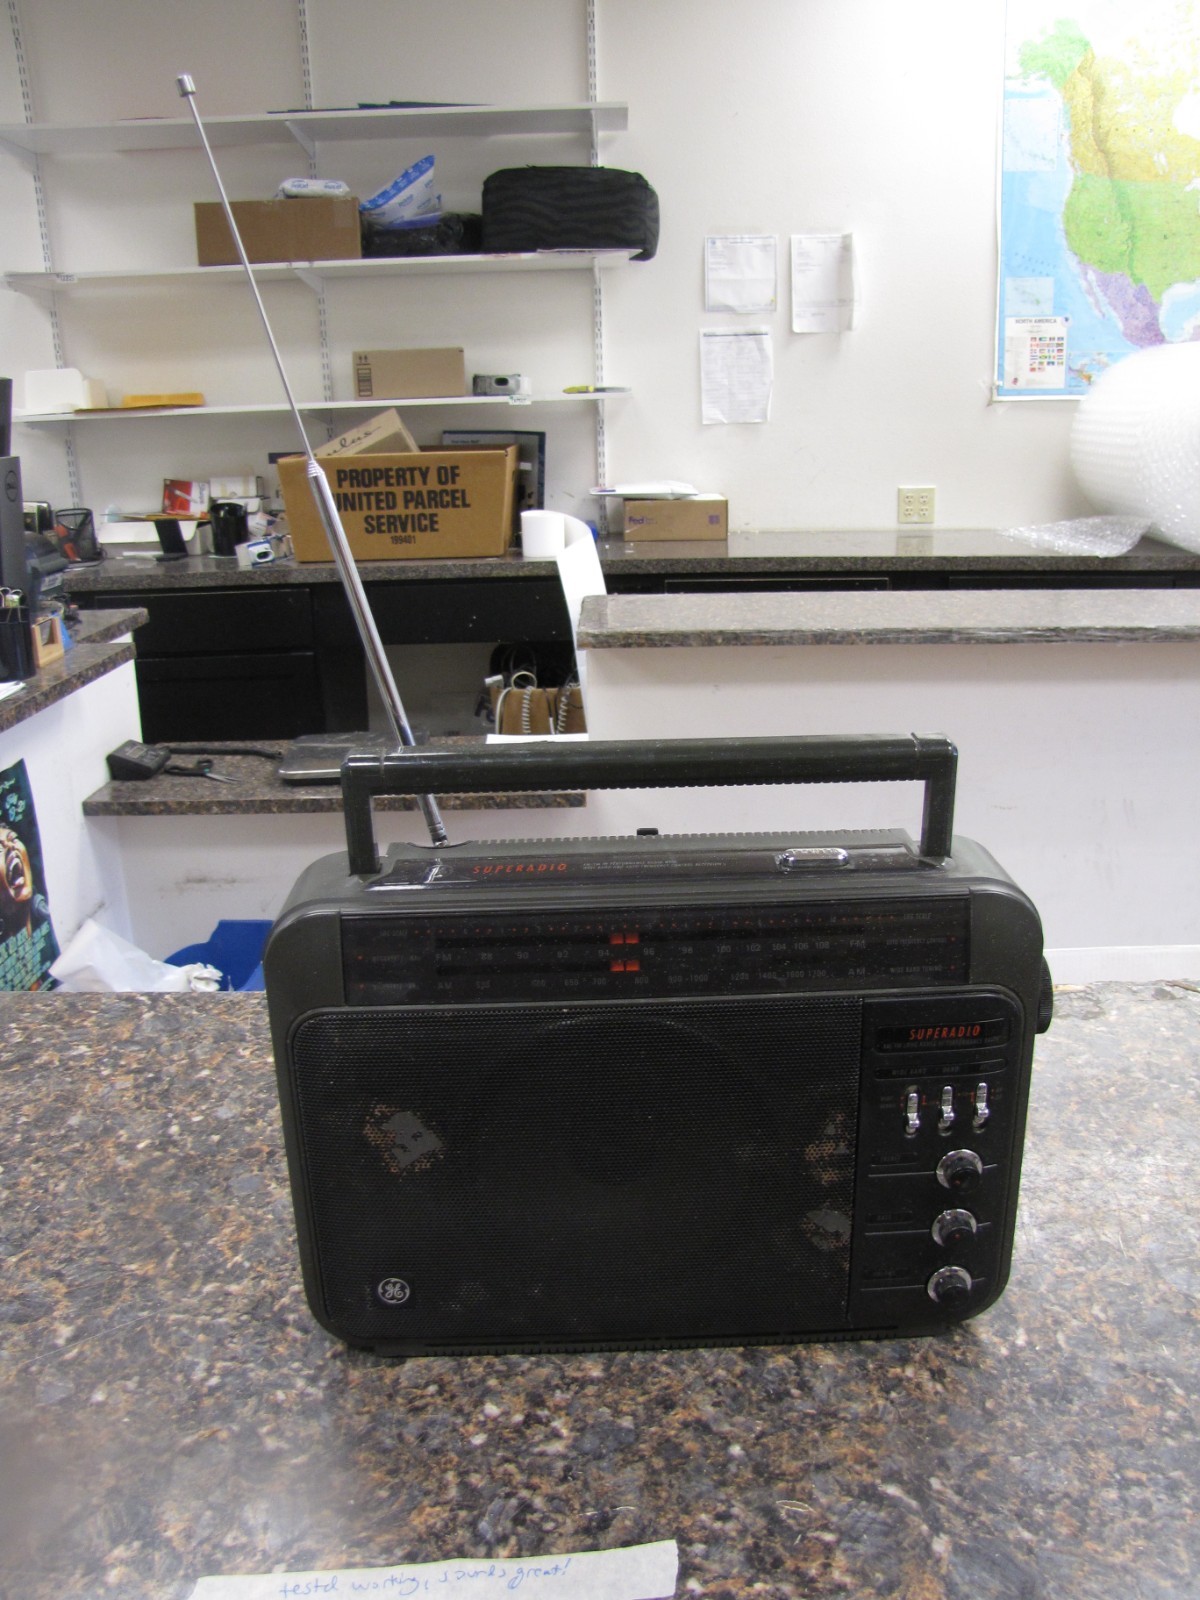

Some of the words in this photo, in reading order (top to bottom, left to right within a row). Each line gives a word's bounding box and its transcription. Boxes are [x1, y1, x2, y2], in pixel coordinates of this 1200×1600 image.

[336, 466, 431, 489] PROPERTY
[437, 465, 460, 486] OF
[403, 488, 471, 511] PARCEL
[364, 513, 439, 535] SERVICE
[473, 863, 568, 875] SUPERADIO
[517, 951, 529, 959] 90
[643, 948, 655, 956] 96
[716, 945, 731, 953] 100
[746, 944, 761, 952] 102
[772, 943, 786, 951] 104
[794, 942, 809, 950] 106
[815, 941, 830, 949] 108
[848, 968, 865, 976] AM
[909, 1024, 982, 1041] SUPERADIO
[438, 1564, 507, 1583] sounds
[507, 1557, 572, 1590] great!
